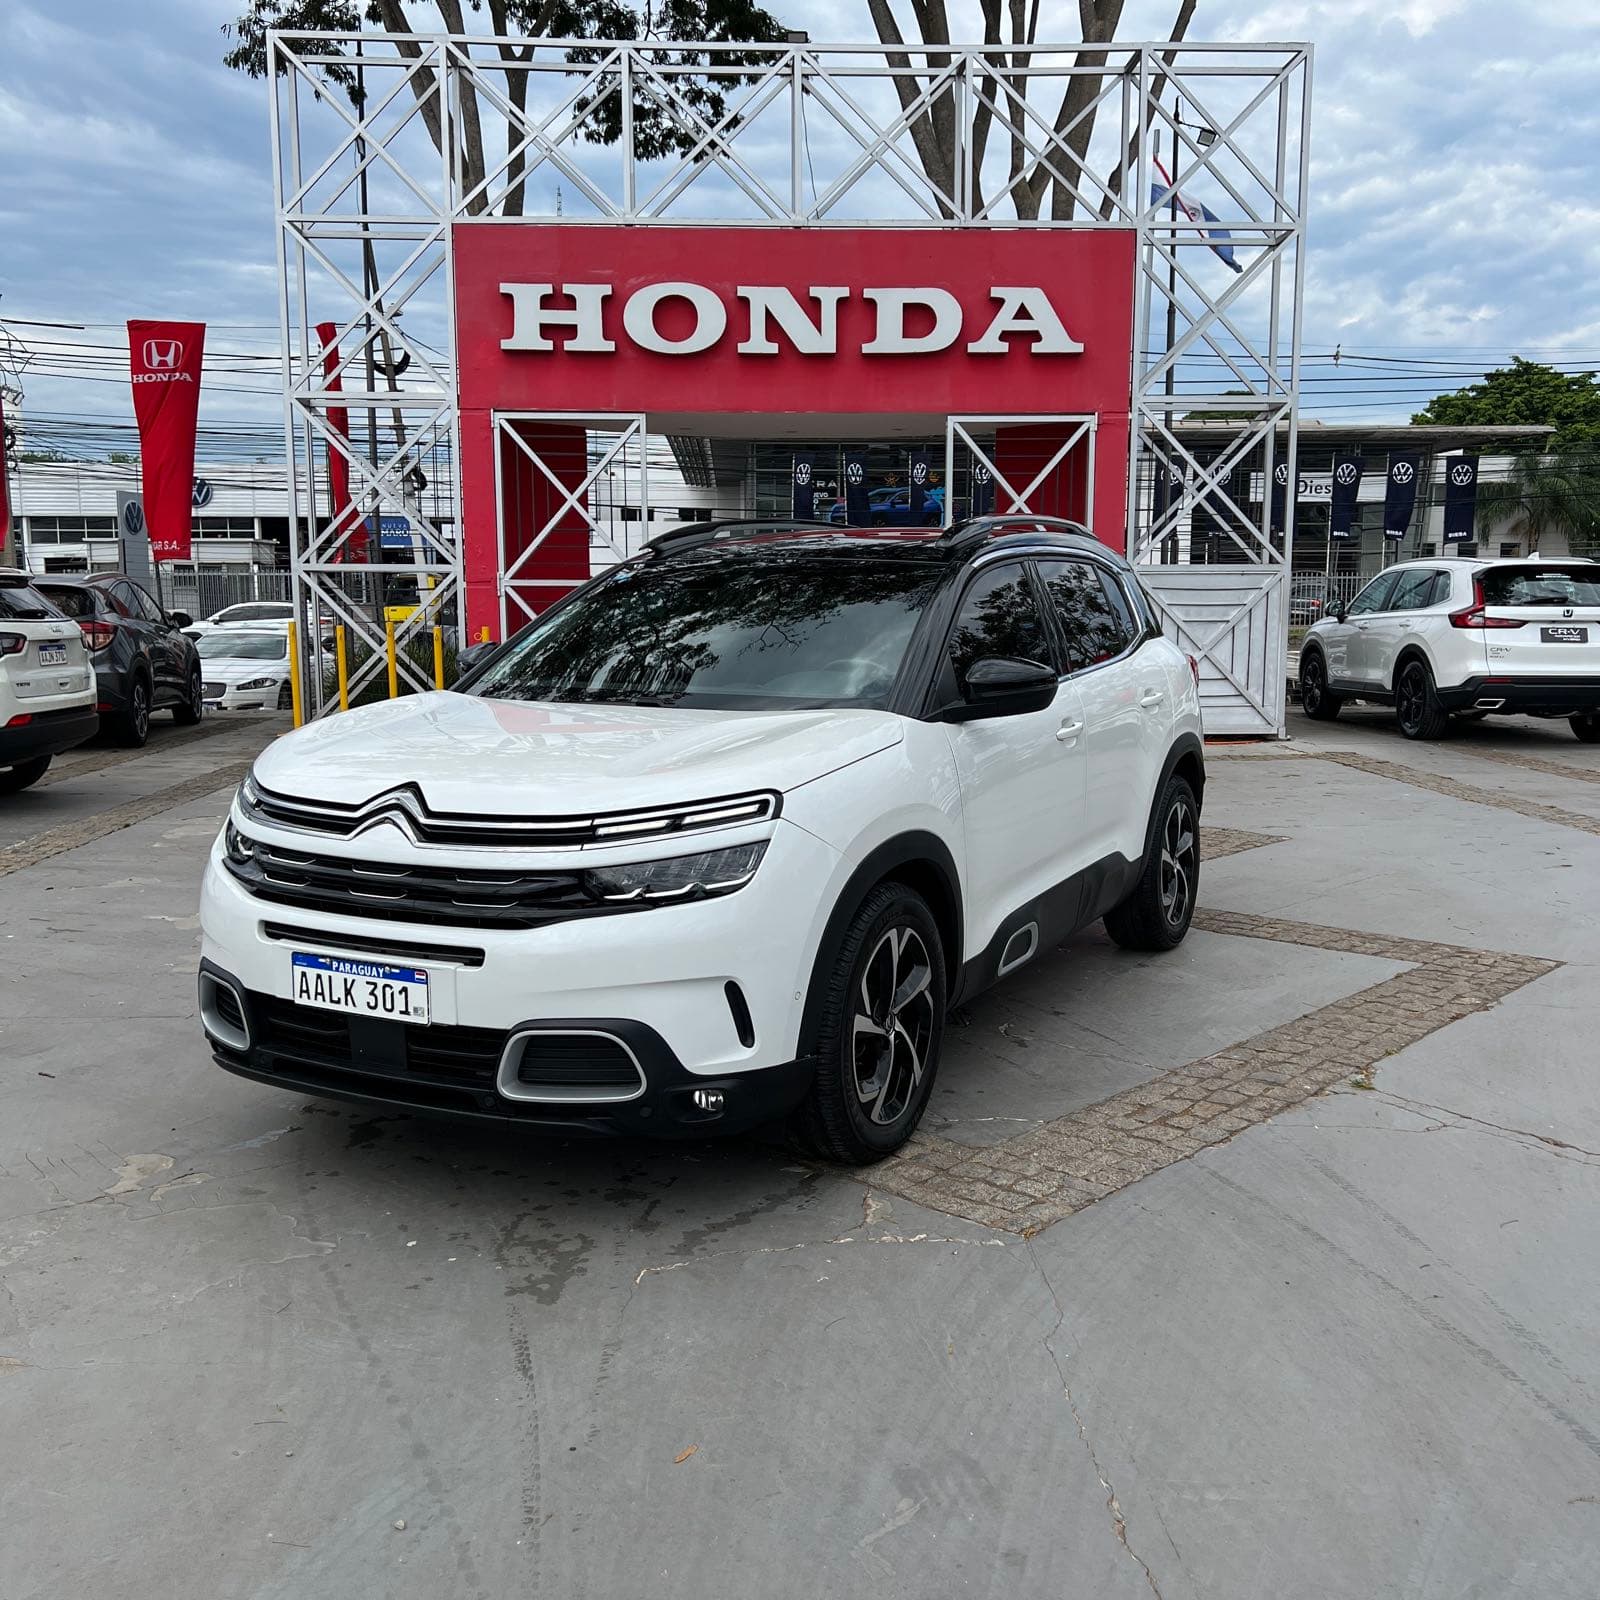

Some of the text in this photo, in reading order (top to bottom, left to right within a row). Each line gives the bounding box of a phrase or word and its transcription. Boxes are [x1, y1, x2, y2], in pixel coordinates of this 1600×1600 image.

[499, 281, 1084, 355] HONDA
[132, 372, 193, 383] HONDA
[332, 961, 384, 977] PARAGUAY
[299, 970, 411, 1016] AALK 301
